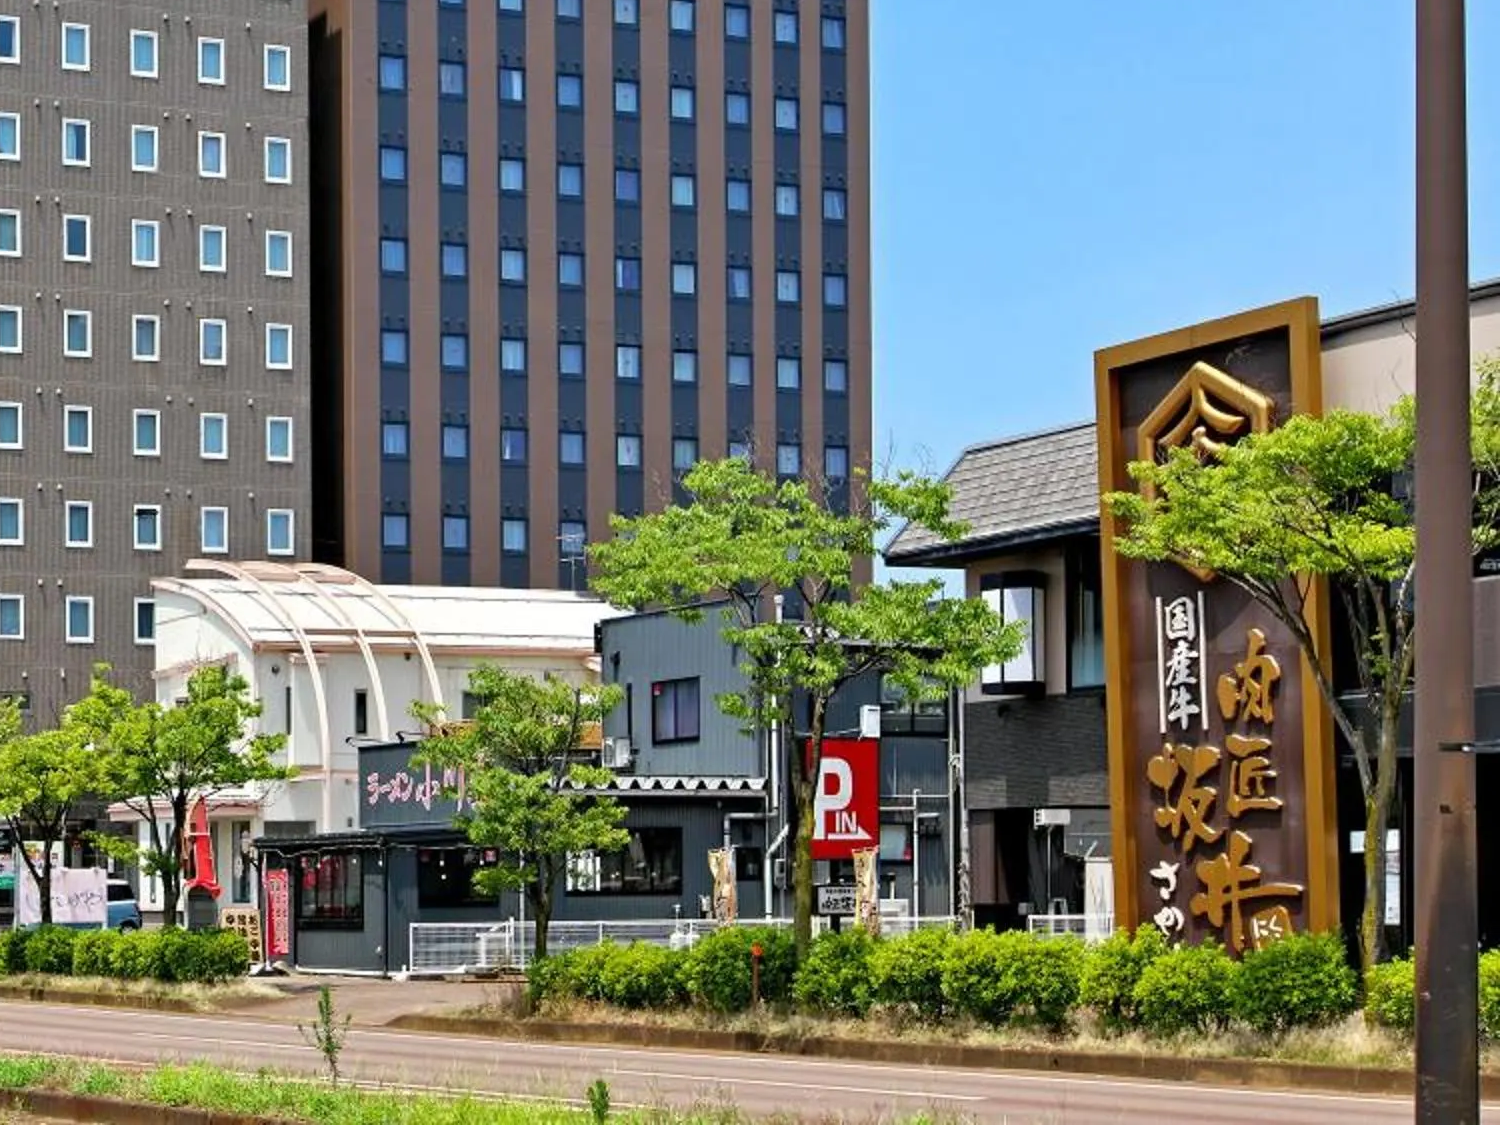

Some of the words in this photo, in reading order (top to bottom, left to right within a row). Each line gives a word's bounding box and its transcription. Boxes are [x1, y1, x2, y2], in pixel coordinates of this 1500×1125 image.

[1163, 594, 1200, 731] 国産牛
[814, 758, 853, 840] P
[835, 811, 857, 834] IN
